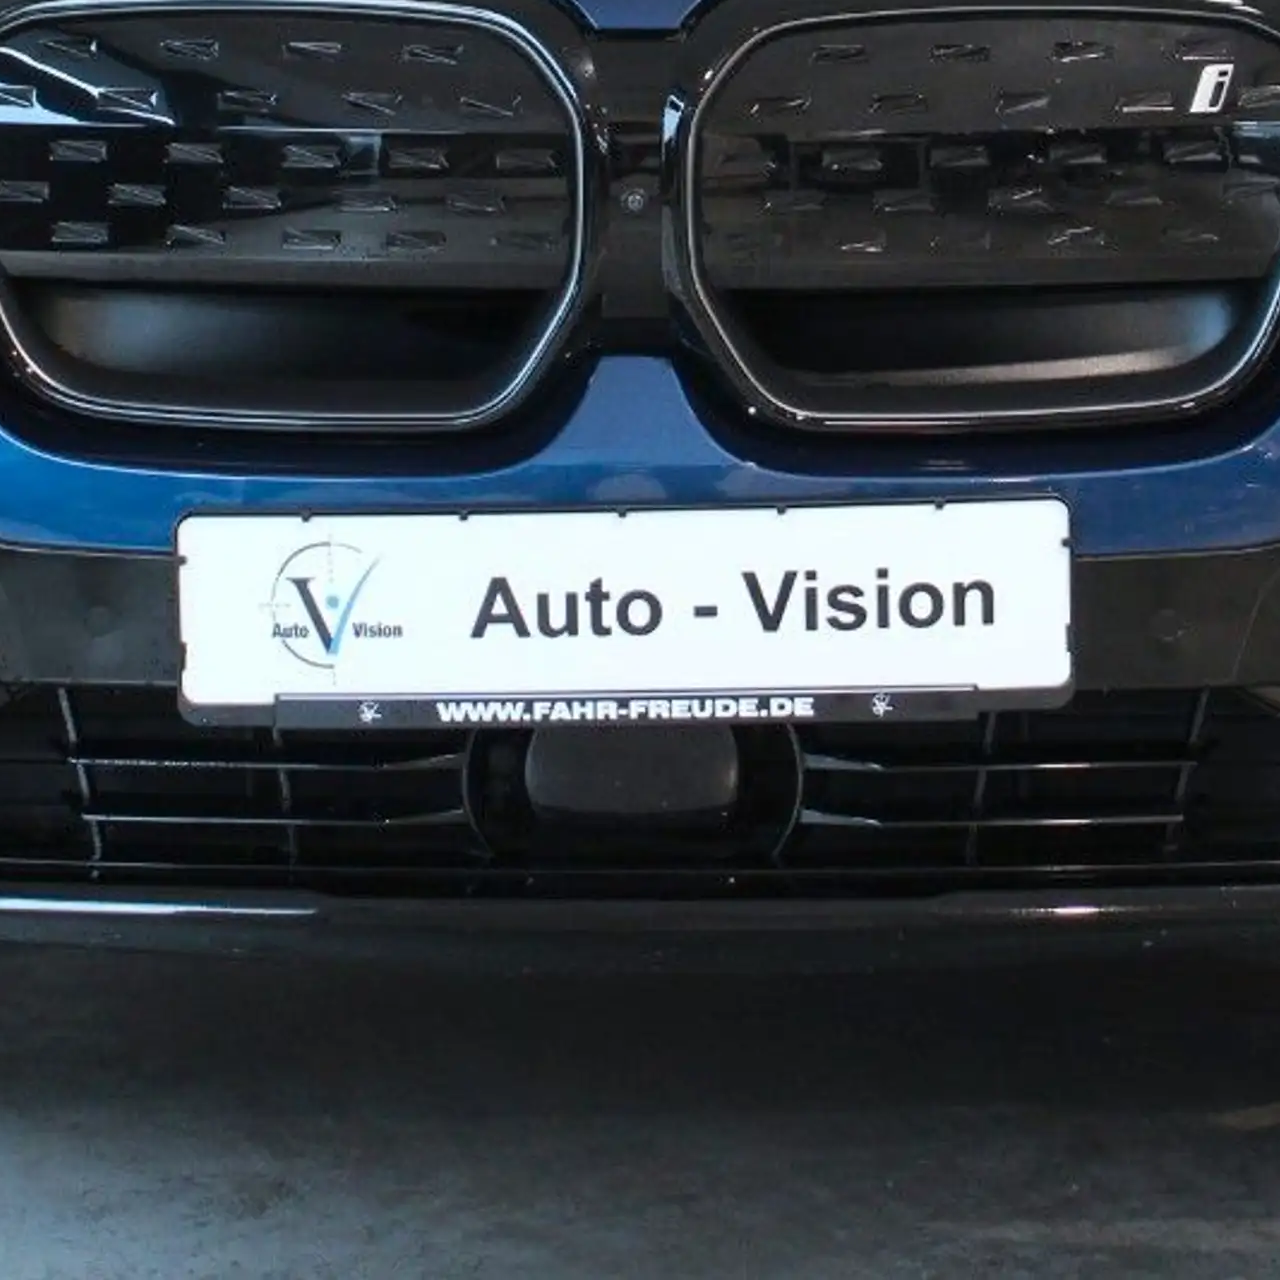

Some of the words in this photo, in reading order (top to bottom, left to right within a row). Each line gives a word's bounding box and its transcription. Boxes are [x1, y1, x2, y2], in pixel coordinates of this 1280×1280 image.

[470, 576, 664, 639] Auto
[693, 605, 718, 618] -
[741, 567, 995, 632] Vision
[271, 622, 310, 639] Auto
[351, 621, 404, 639] Vision
[435, 697, 815, 723] WWW.FAHR-FREUDE.DE
